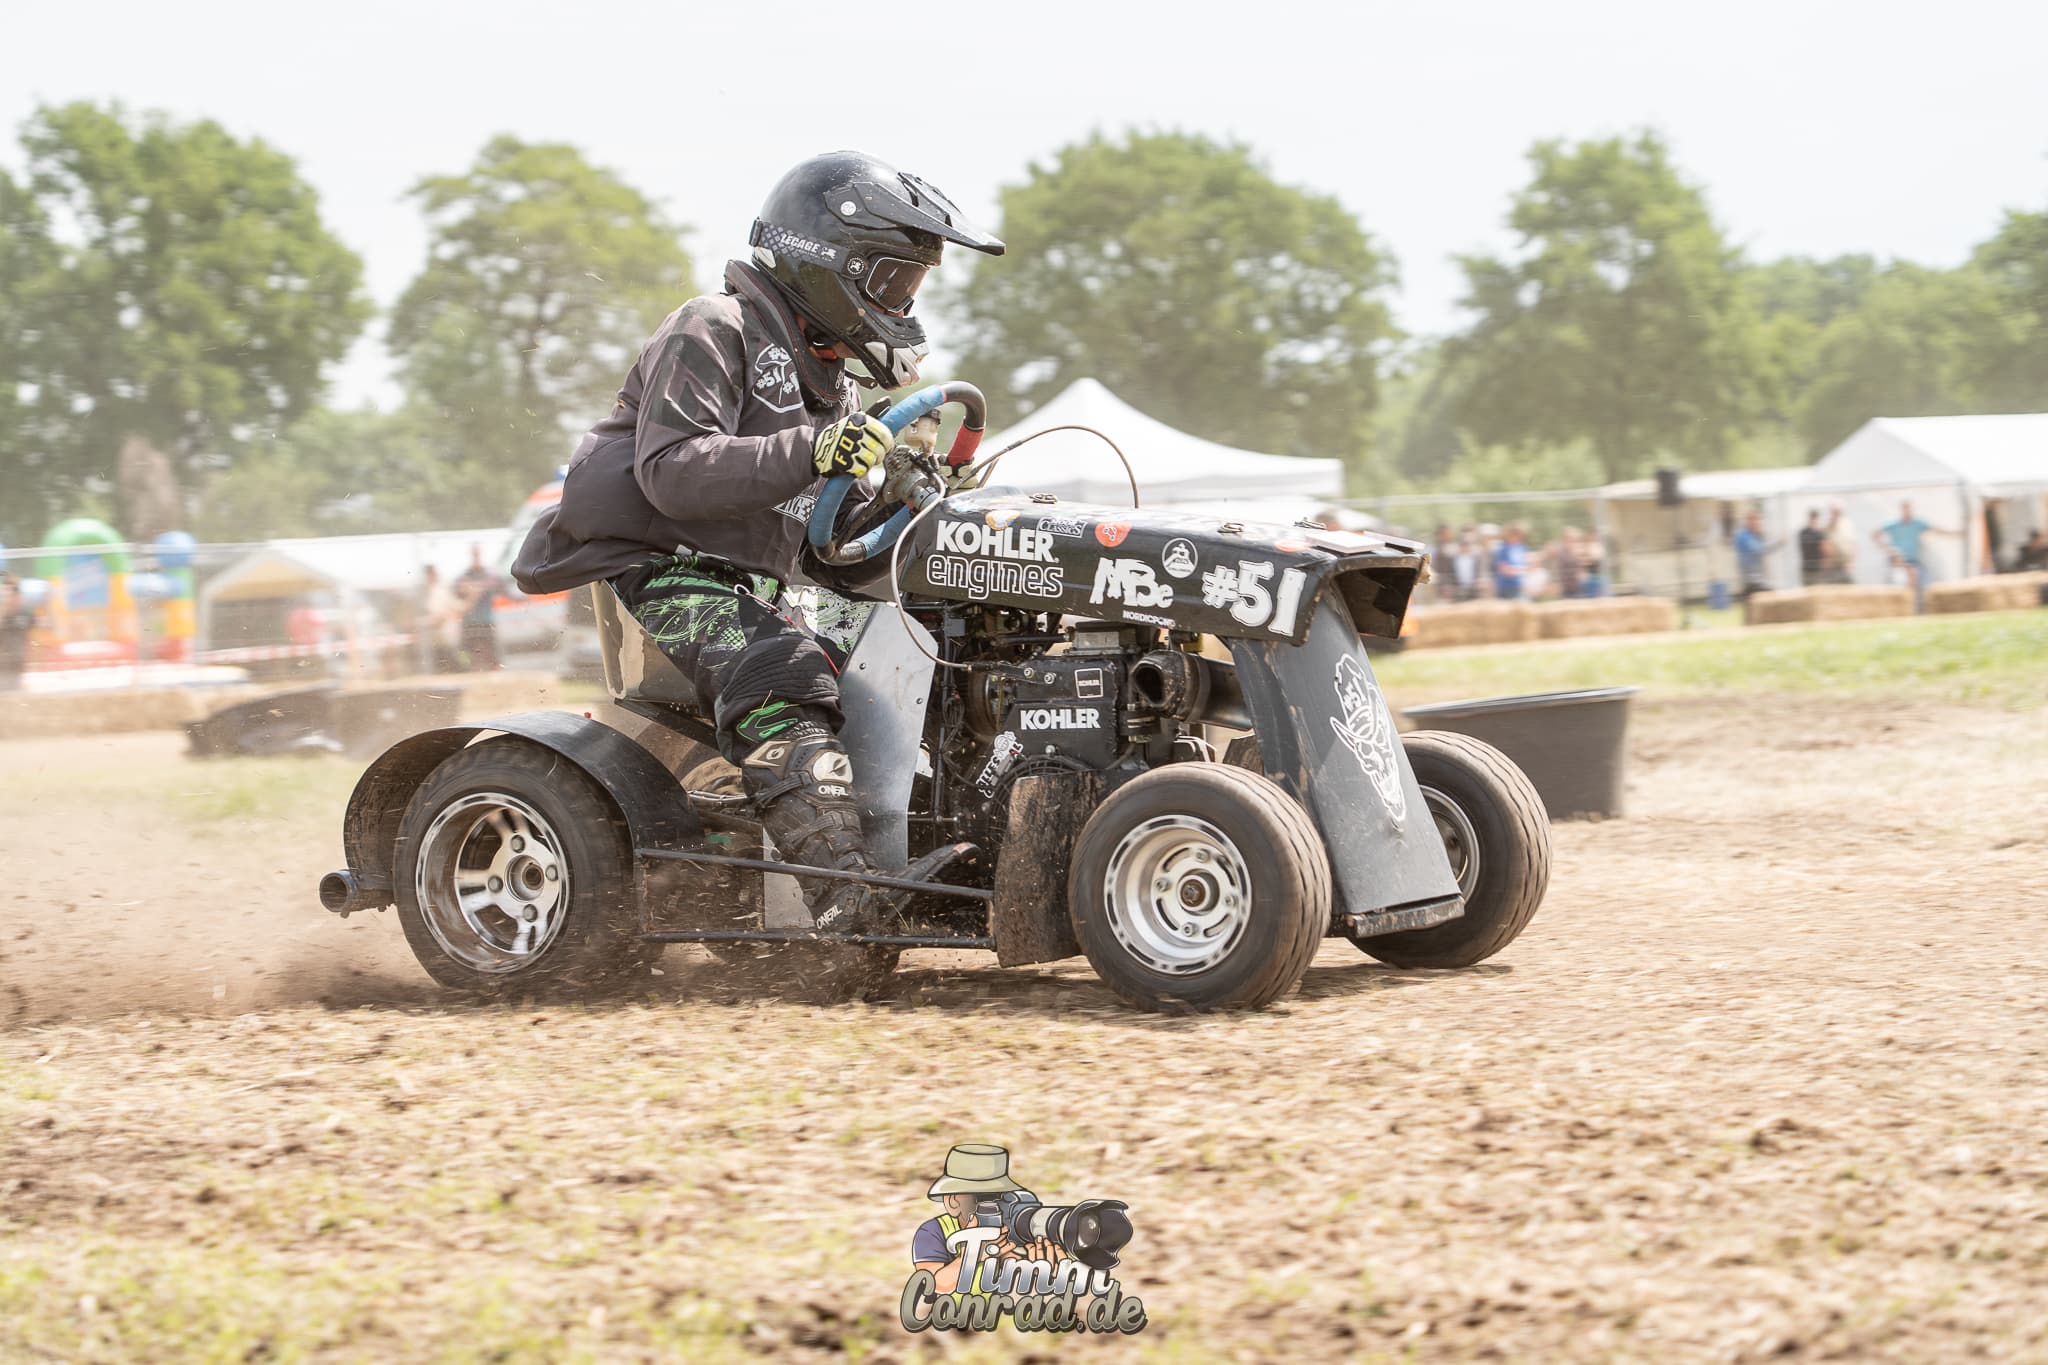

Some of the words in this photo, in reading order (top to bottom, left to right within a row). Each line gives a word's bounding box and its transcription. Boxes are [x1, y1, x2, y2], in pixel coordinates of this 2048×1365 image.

[756, 367, 782, 389] #51
[936, 519, 1059, 563] KOHLER
[926, 554, 1064, 600] engines
[1202, 560, 1307, 637] #51
[1342, 676, 1368, 712] #51
[1020, 708, 1101, 730] KOHLER
